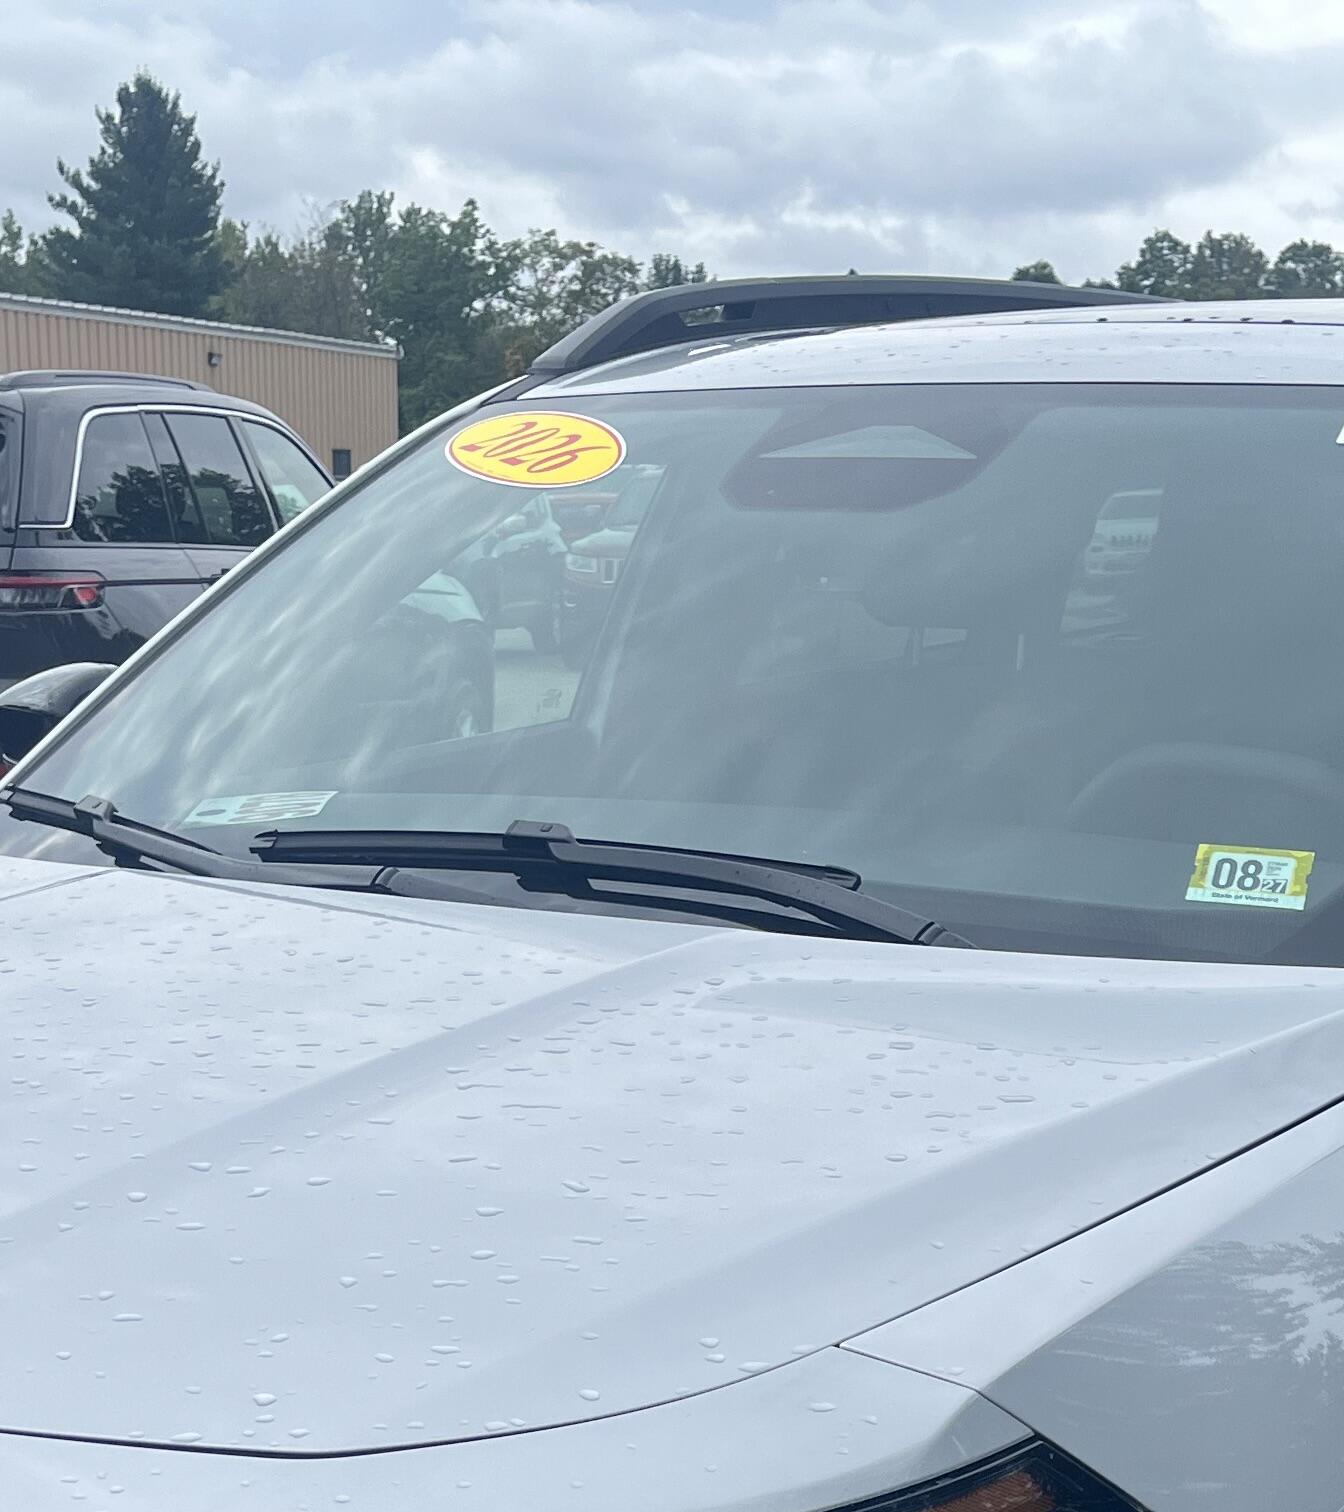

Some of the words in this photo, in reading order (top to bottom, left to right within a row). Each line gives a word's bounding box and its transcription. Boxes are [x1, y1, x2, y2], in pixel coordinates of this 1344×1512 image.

[459, 421, 612, 474] 2026
[1211, 858, 1264, 891] 08
[1261, 879, 1287, 894] 27
